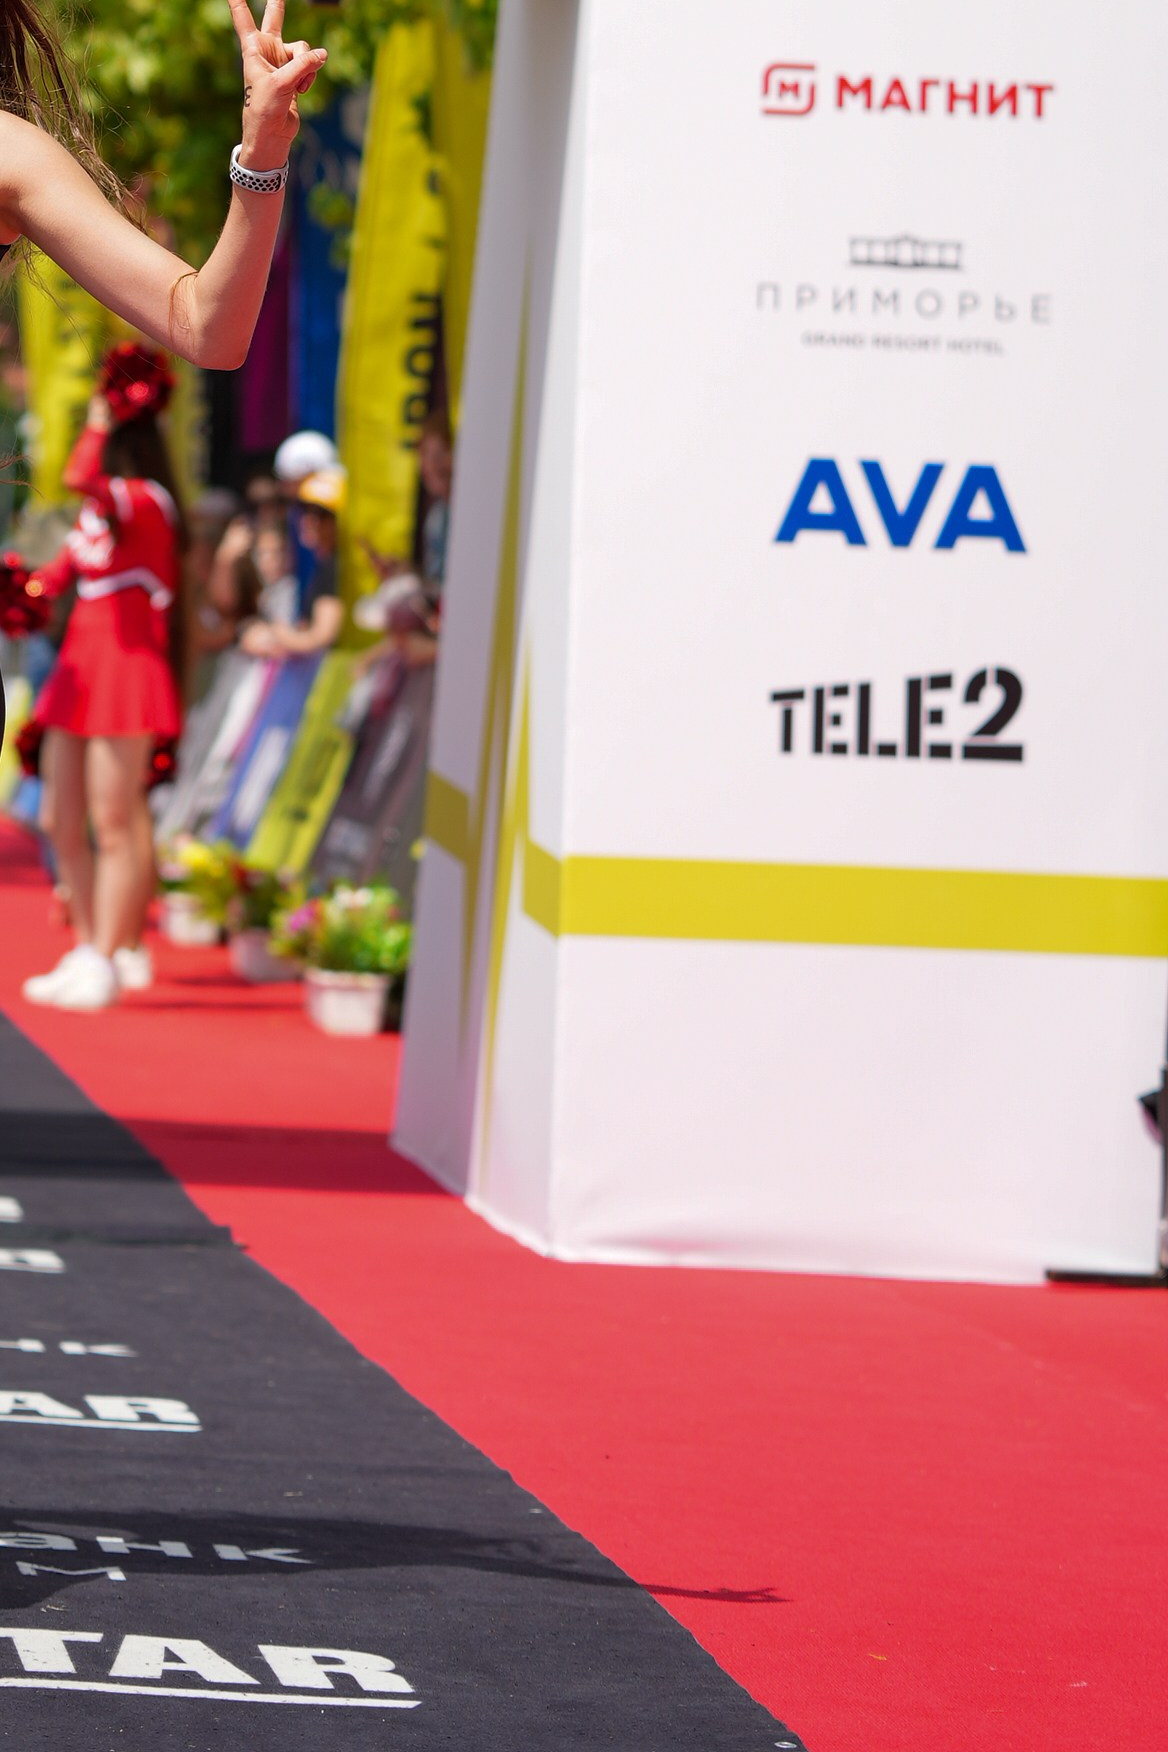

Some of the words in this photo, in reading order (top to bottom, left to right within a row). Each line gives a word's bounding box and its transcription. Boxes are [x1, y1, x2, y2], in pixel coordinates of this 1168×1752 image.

[836, 74, 1054, 118] МАГНИТ
[756, 282, 1052, 324] ПРИМОРЬЕ
[774, 457, 1027, 553] AVA
[769, 667, 1024, 762] TELE2
